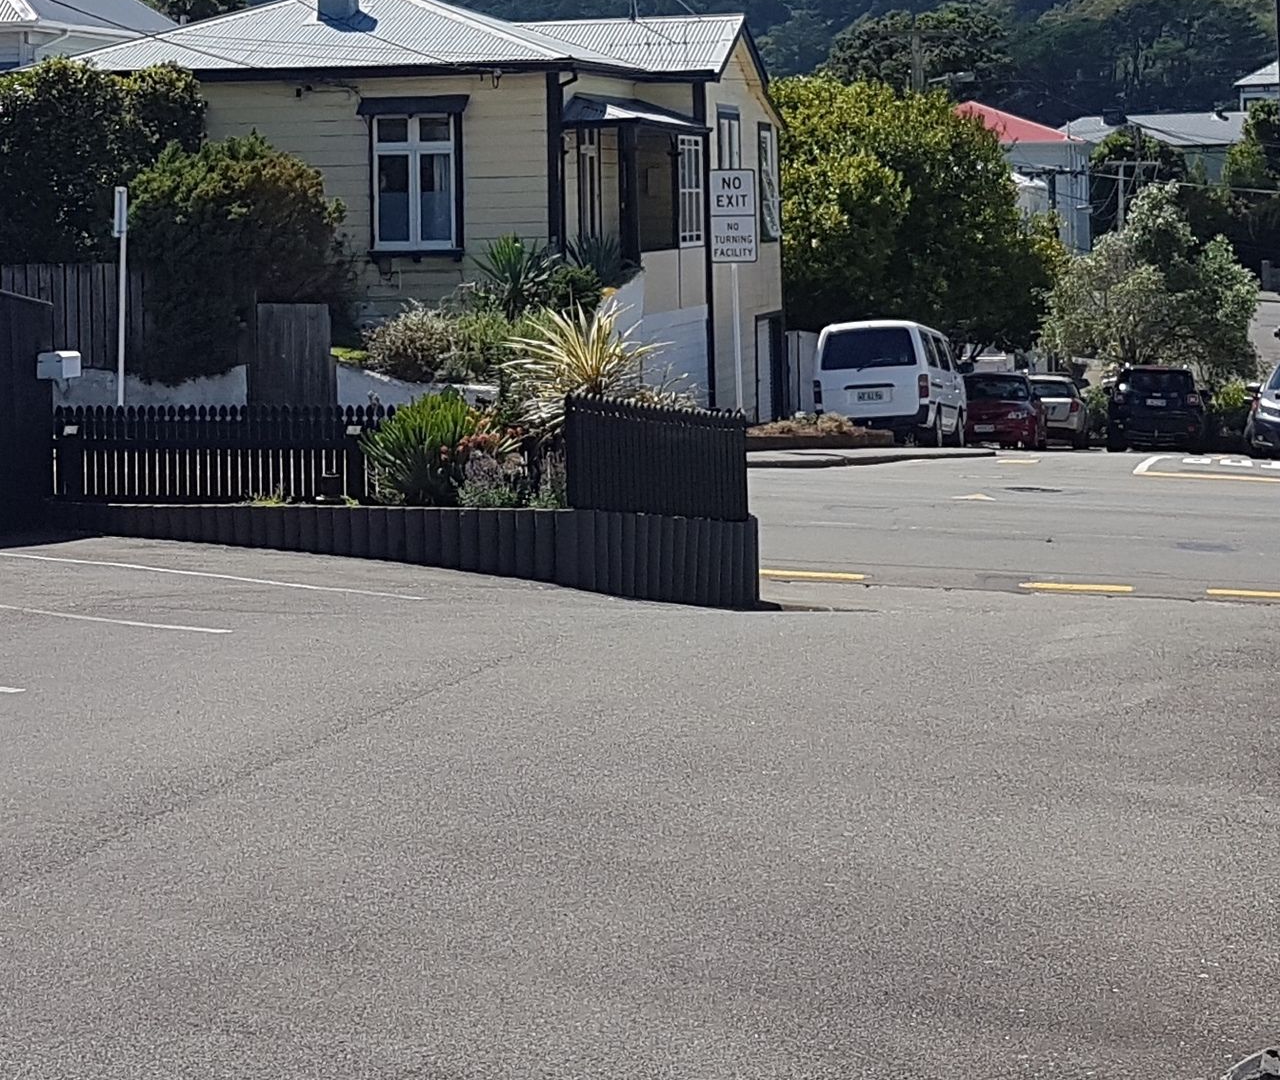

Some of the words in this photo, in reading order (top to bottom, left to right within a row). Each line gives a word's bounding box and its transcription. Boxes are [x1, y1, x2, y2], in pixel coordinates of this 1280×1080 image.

[721, 176, 742, 190] NO
[716, 194, 748, 208] EXIT
[726, 222, 740, 231] NO
[714, 234, 753, 245] TURNING
[713, 248, 754, 258] FACILITY
